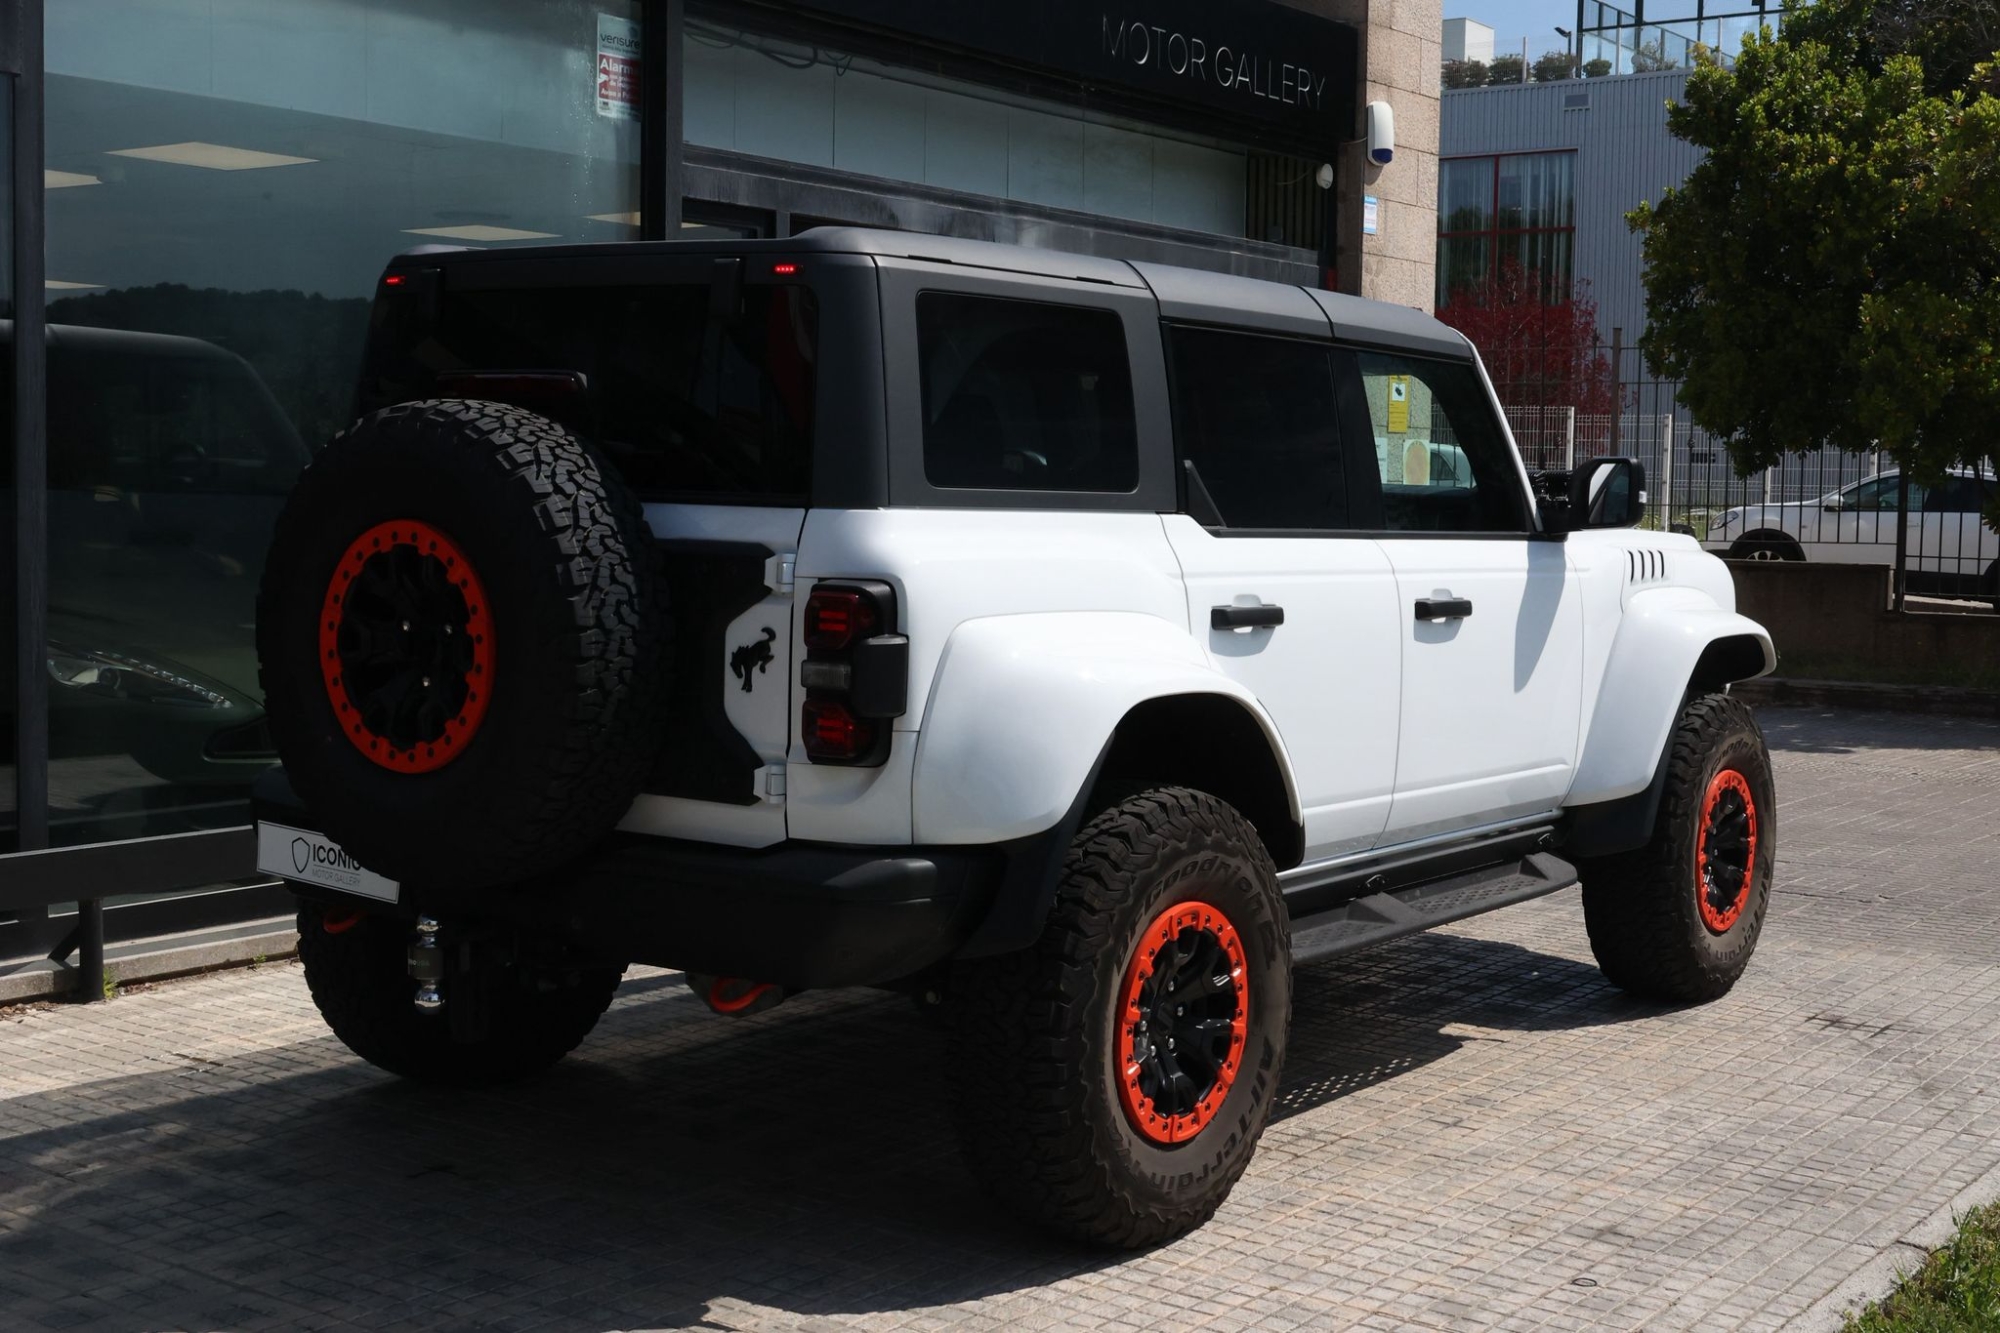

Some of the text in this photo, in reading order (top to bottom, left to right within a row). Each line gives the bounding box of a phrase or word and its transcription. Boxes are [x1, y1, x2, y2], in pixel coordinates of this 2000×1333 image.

[600, 33, 641, 49] verisure
[1103, 14, 1326, 110] MOTOR GALLERY
